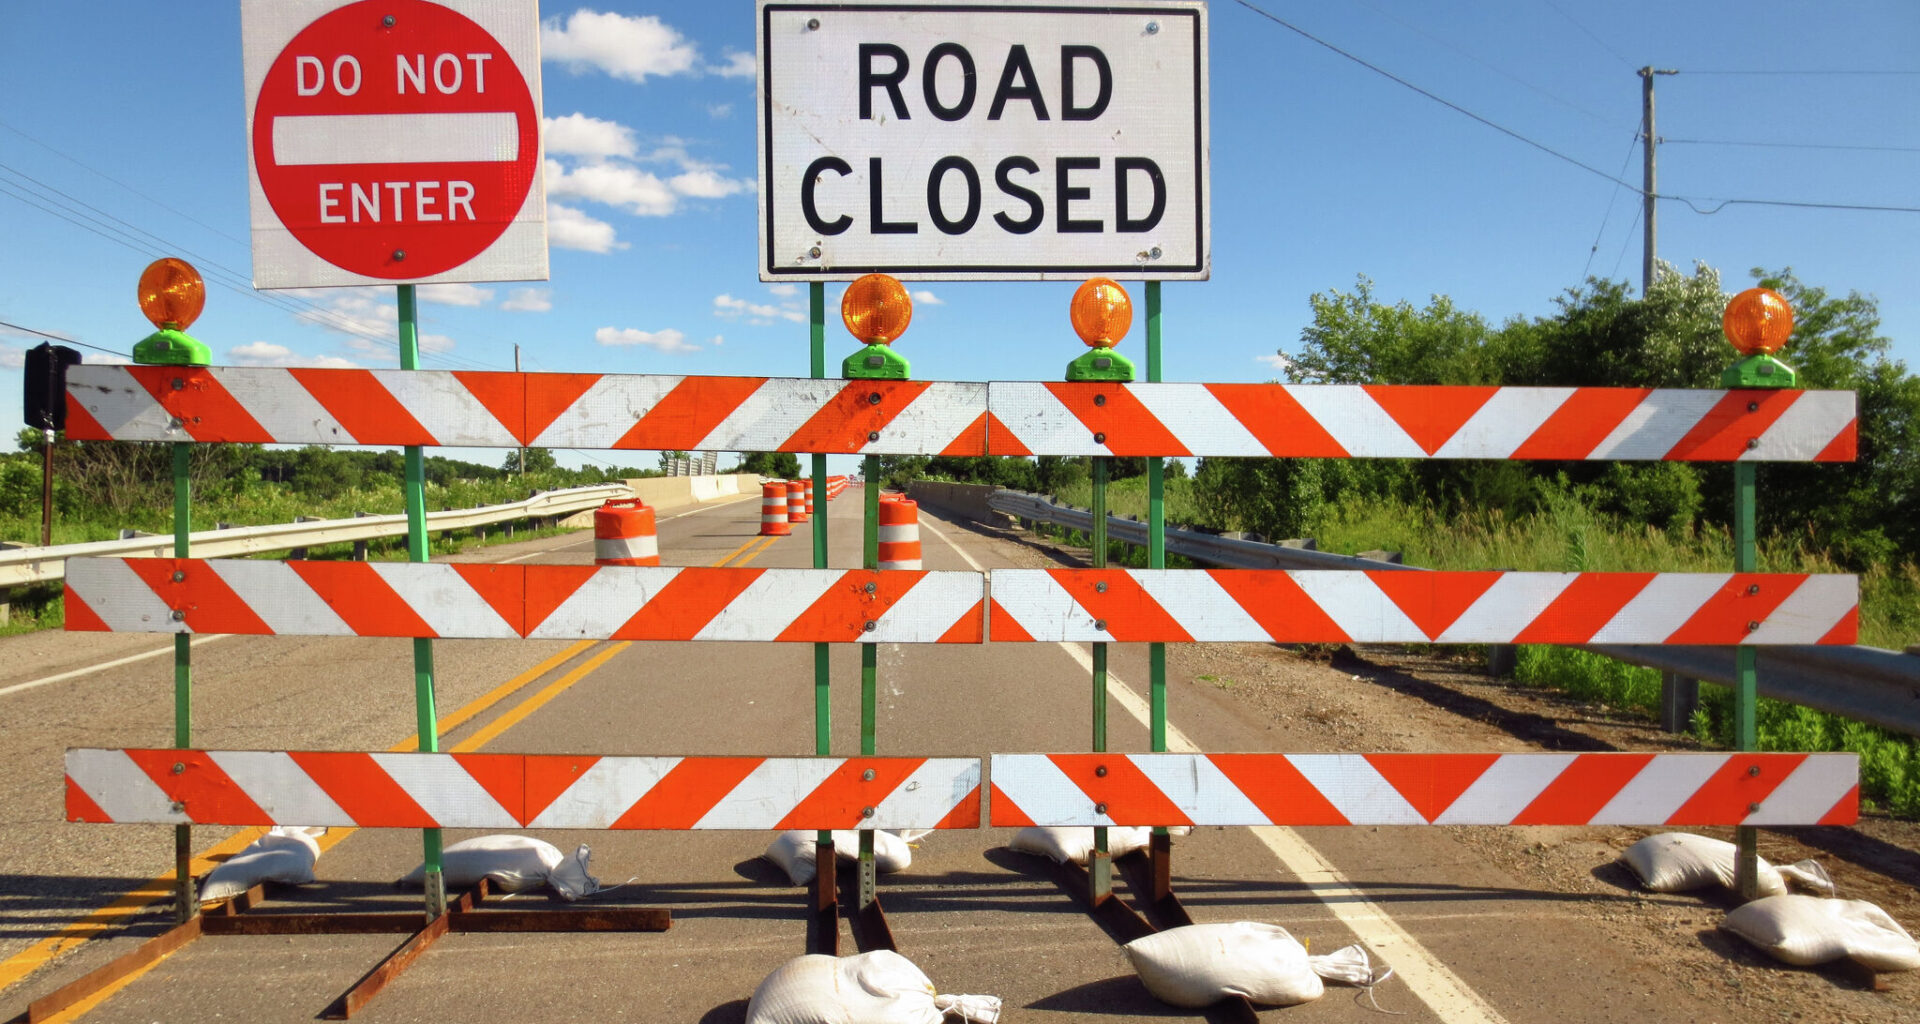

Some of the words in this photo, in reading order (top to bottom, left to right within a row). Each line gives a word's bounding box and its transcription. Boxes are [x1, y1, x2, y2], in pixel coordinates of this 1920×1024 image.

[296, 54, 362, 97] DO
[396, 52, 492, 95] NOT
[858, 42, 1113, 122] ROAD
[319, 180, 476, 224] ENTER
[801, 155, 1167, 236] CLOSED
